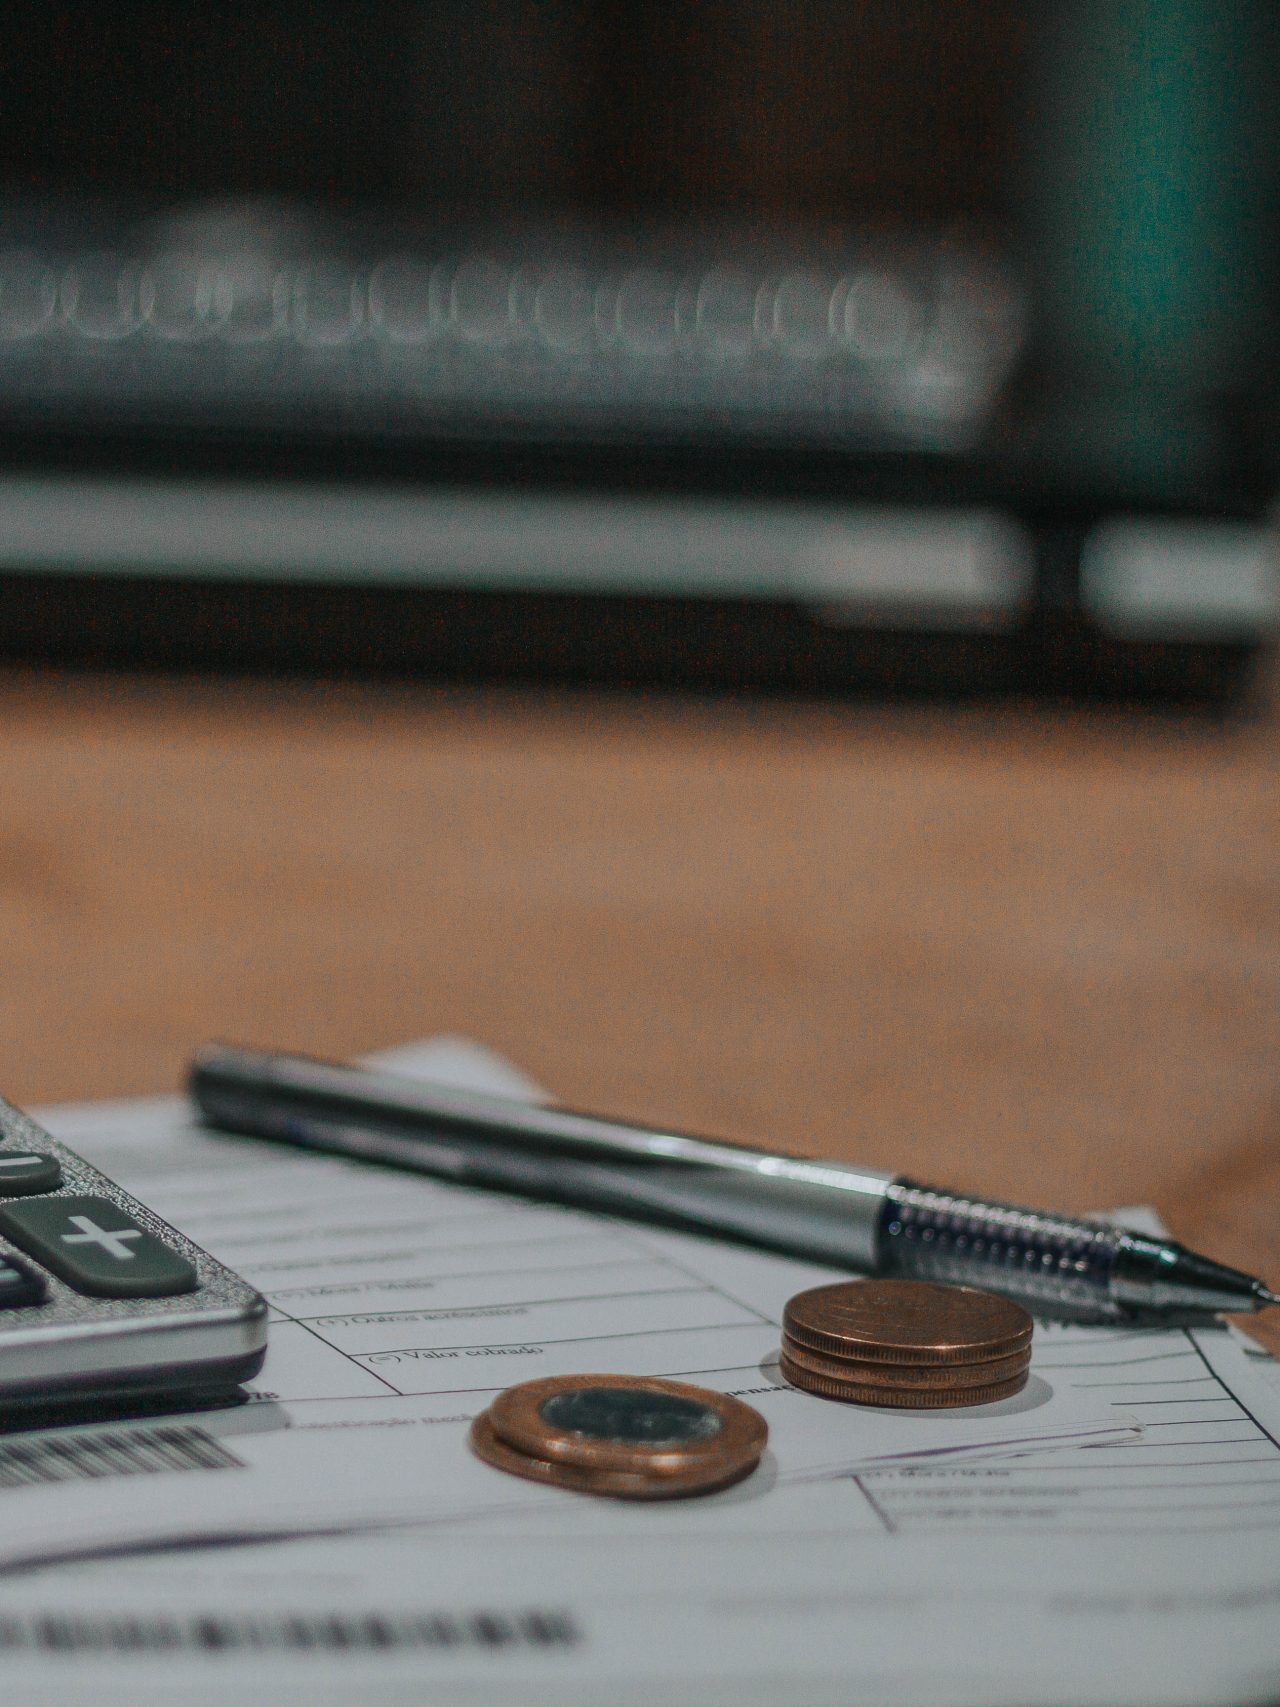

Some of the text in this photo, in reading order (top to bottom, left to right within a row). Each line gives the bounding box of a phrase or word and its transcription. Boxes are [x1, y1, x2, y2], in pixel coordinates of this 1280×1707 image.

[352, 1311, 418, 1325] Outros
[403, 1350, 460, 1361] Valor
[466, 1345, 544, 1359] cobrado
